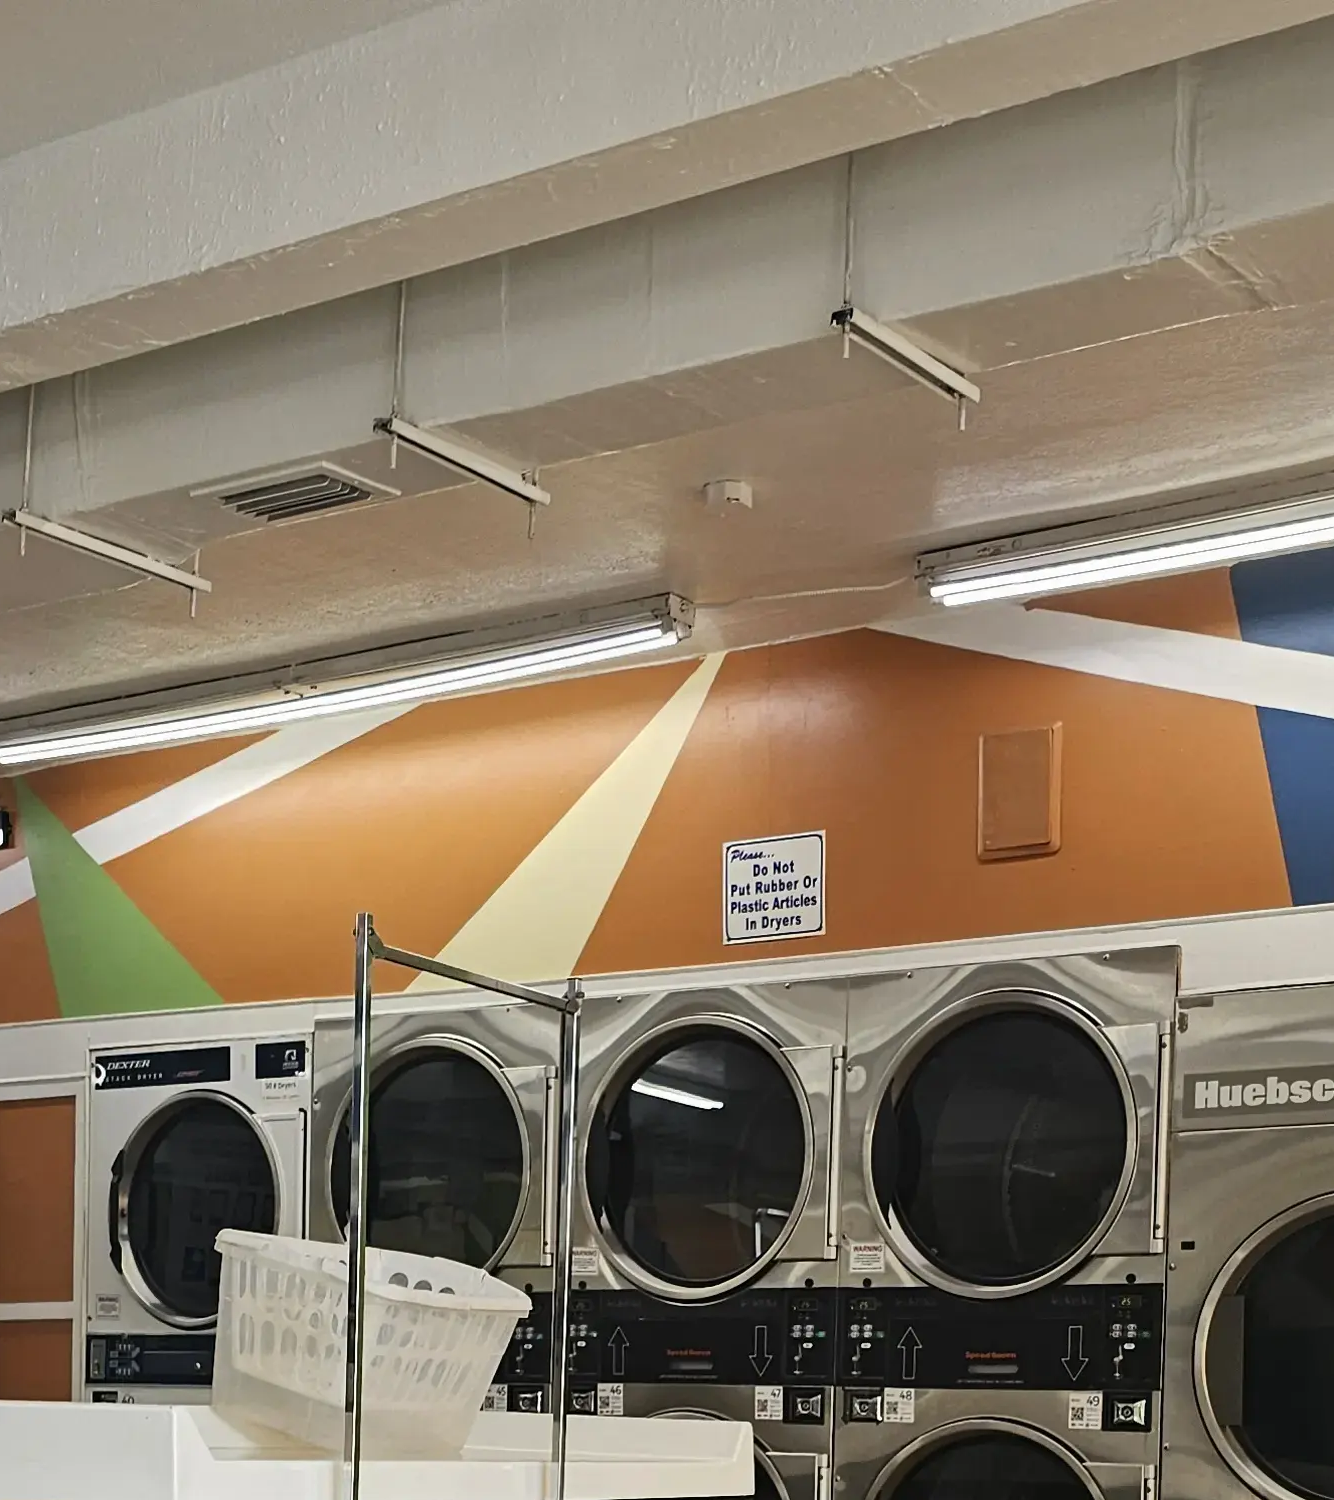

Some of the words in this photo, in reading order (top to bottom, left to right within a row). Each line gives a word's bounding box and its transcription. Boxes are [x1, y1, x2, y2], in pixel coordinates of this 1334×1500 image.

[753, 864, 768, 877] Do
[773, 860, 795, 874] Not
[730, 884, 751, 897] Put
[755, 879, 799, 895] Rubber
[803, 875, 818, 889] Or
[730, 898, 769, 914] Plastic
[772, 894, 817, 910] Articles
[745, 918, 757, 930] In
[761, 914, 802, 931] Dryers
[106, 1060, 150, 1070] DEXTER
[496, 1386, 507, 1397] 45
[610, 1385, 622, 1395] 46
[770, 1388, 782, 1398] 47
[899, 1390, 913, 1401] 48
[1087, 1395, 1100, 1407] 49
